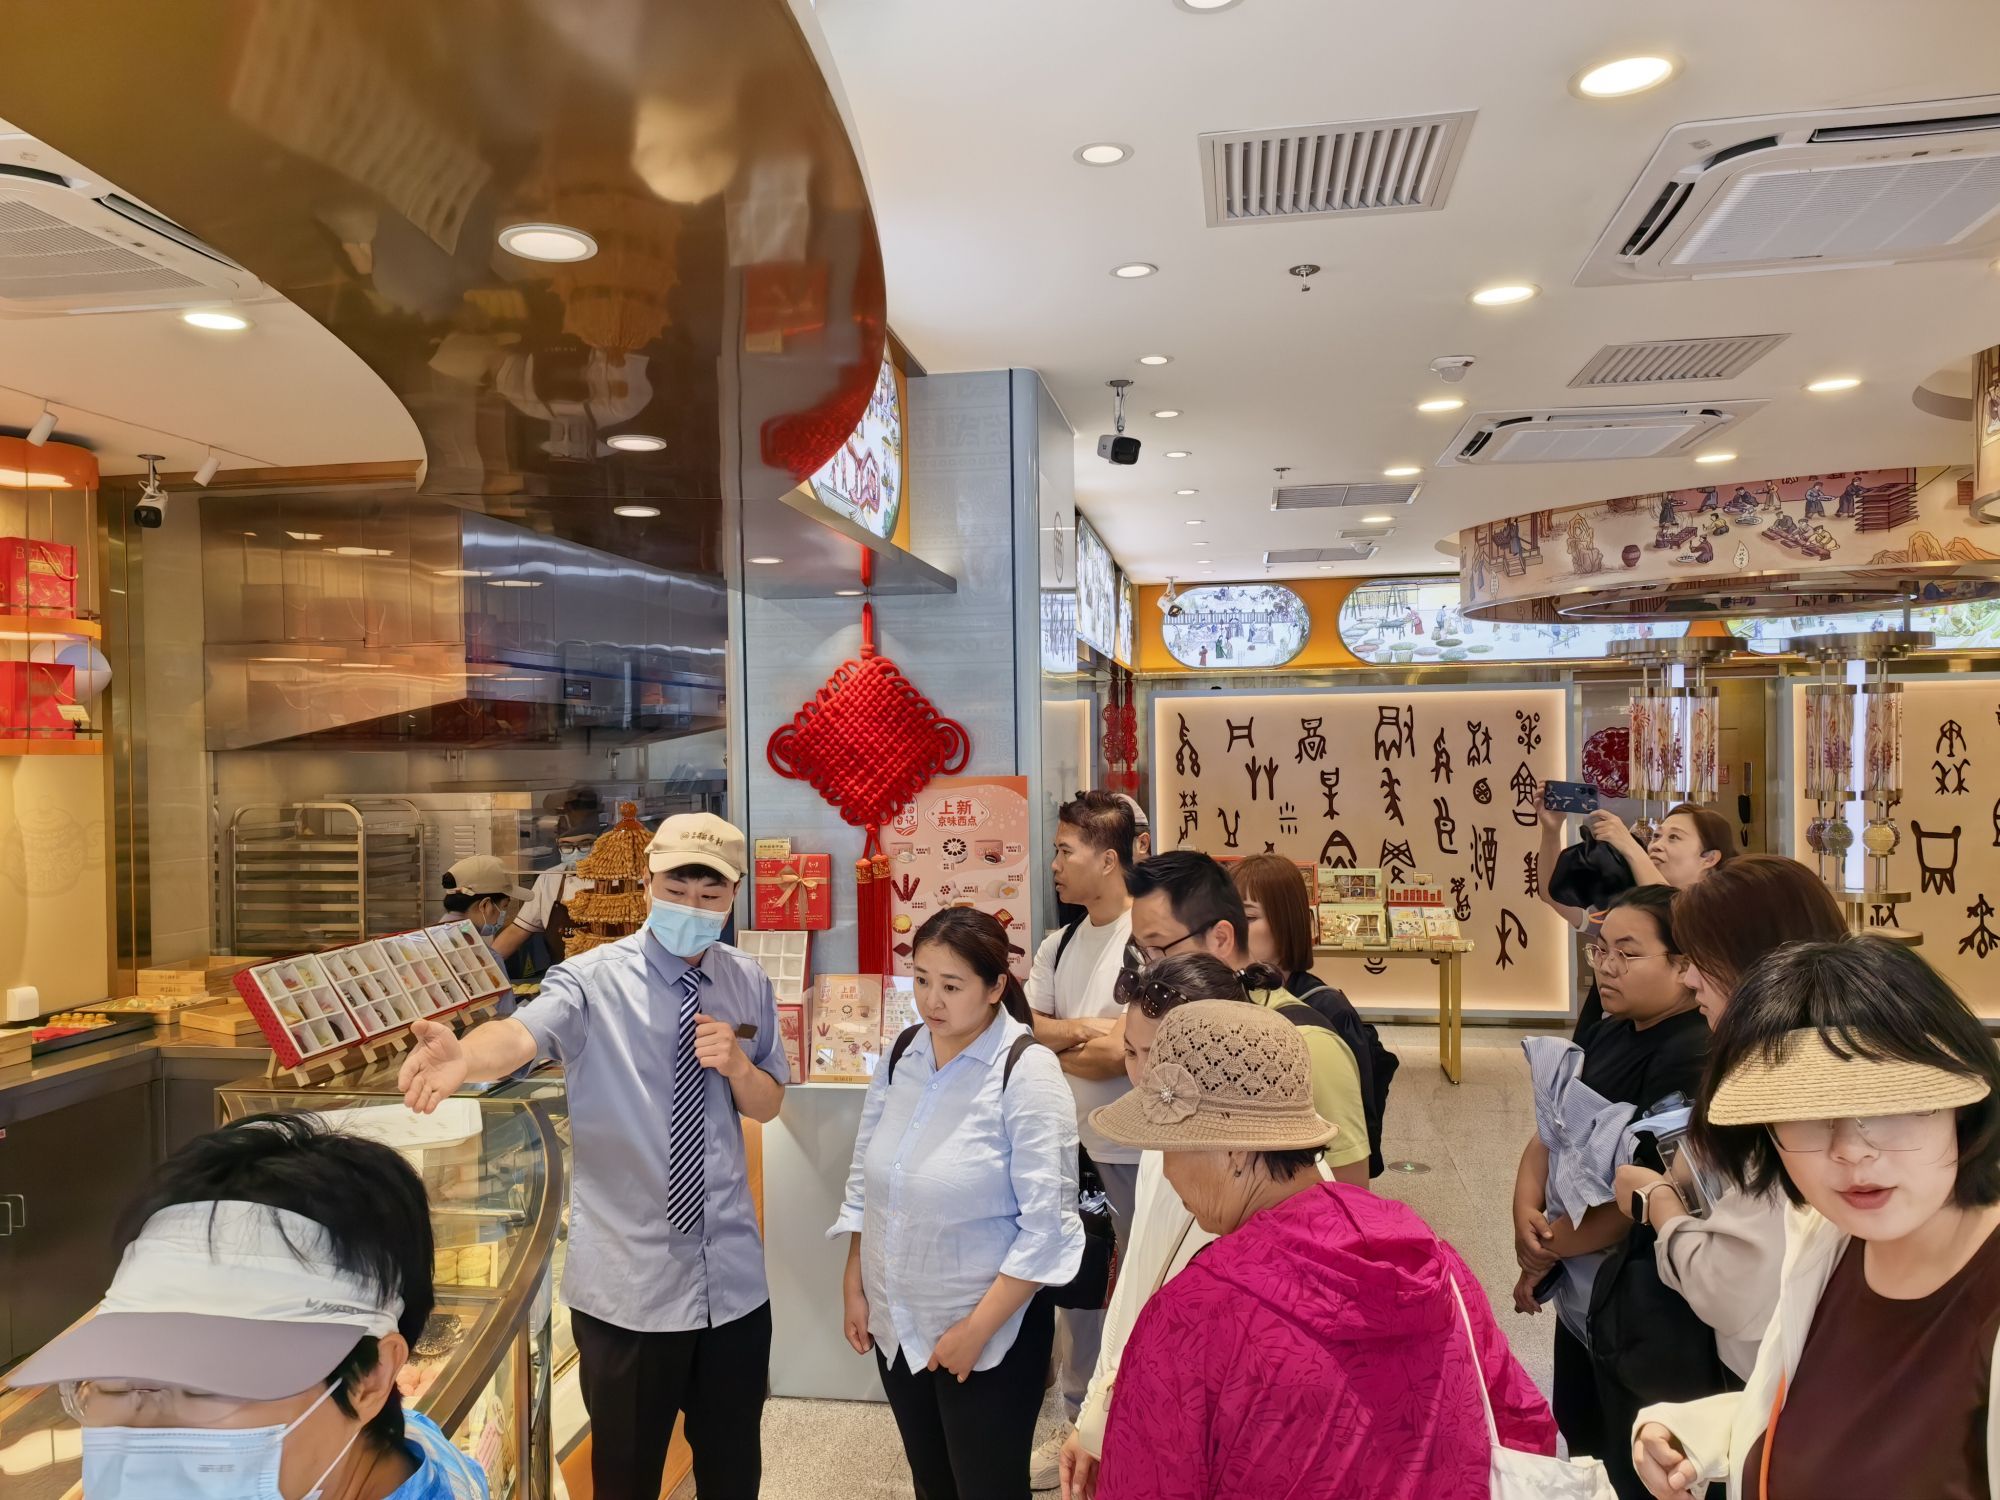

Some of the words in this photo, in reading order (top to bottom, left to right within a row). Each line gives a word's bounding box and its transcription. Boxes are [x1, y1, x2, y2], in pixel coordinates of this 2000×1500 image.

[938, 800, 972, 815] 上新
[938, 816, 977, 827] 京味西点
